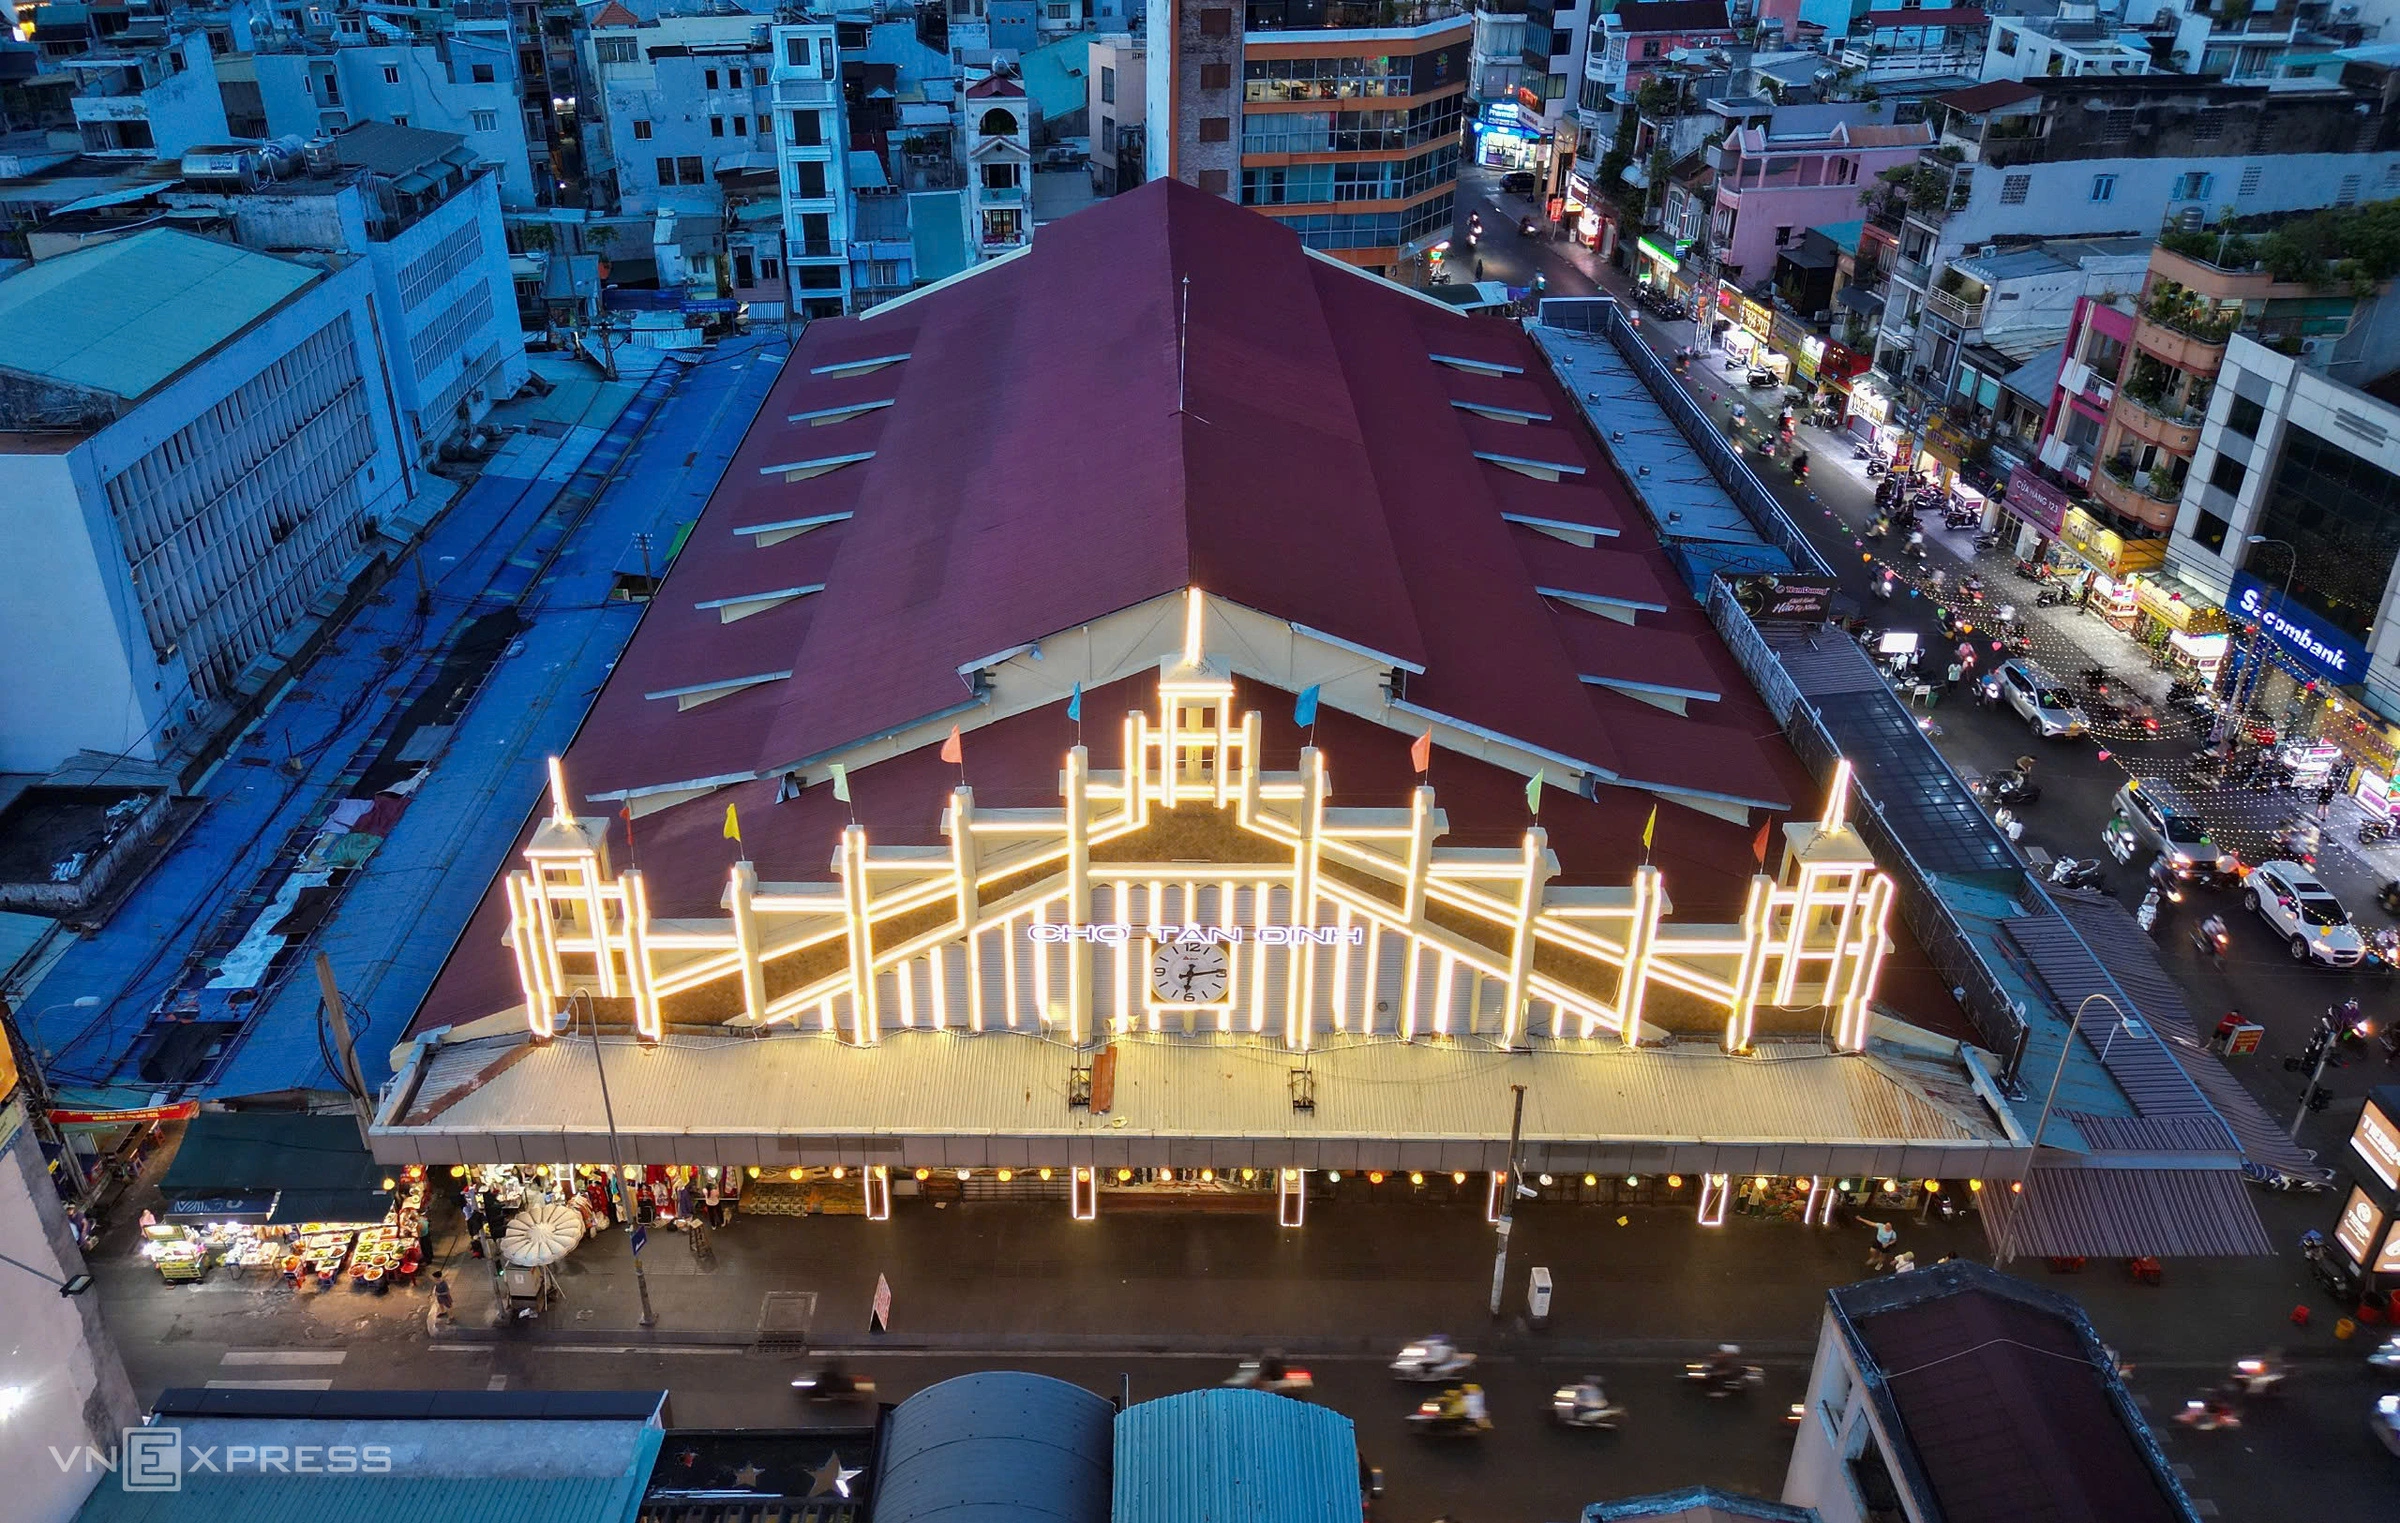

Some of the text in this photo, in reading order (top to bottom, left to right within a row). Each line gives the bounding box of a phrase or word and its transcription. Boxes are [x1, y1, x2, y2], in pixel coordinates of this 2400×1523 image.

[2016, 479, 2029, 493] CỬA
[2048, 500, 2059, 513] 123
[1146, 920, 1243, 945] TÂN
[1184, 942, 1201, 952] 12
[1154, 967, 1166, 977] 9
[1183, 992, 1195, 1002] 6
